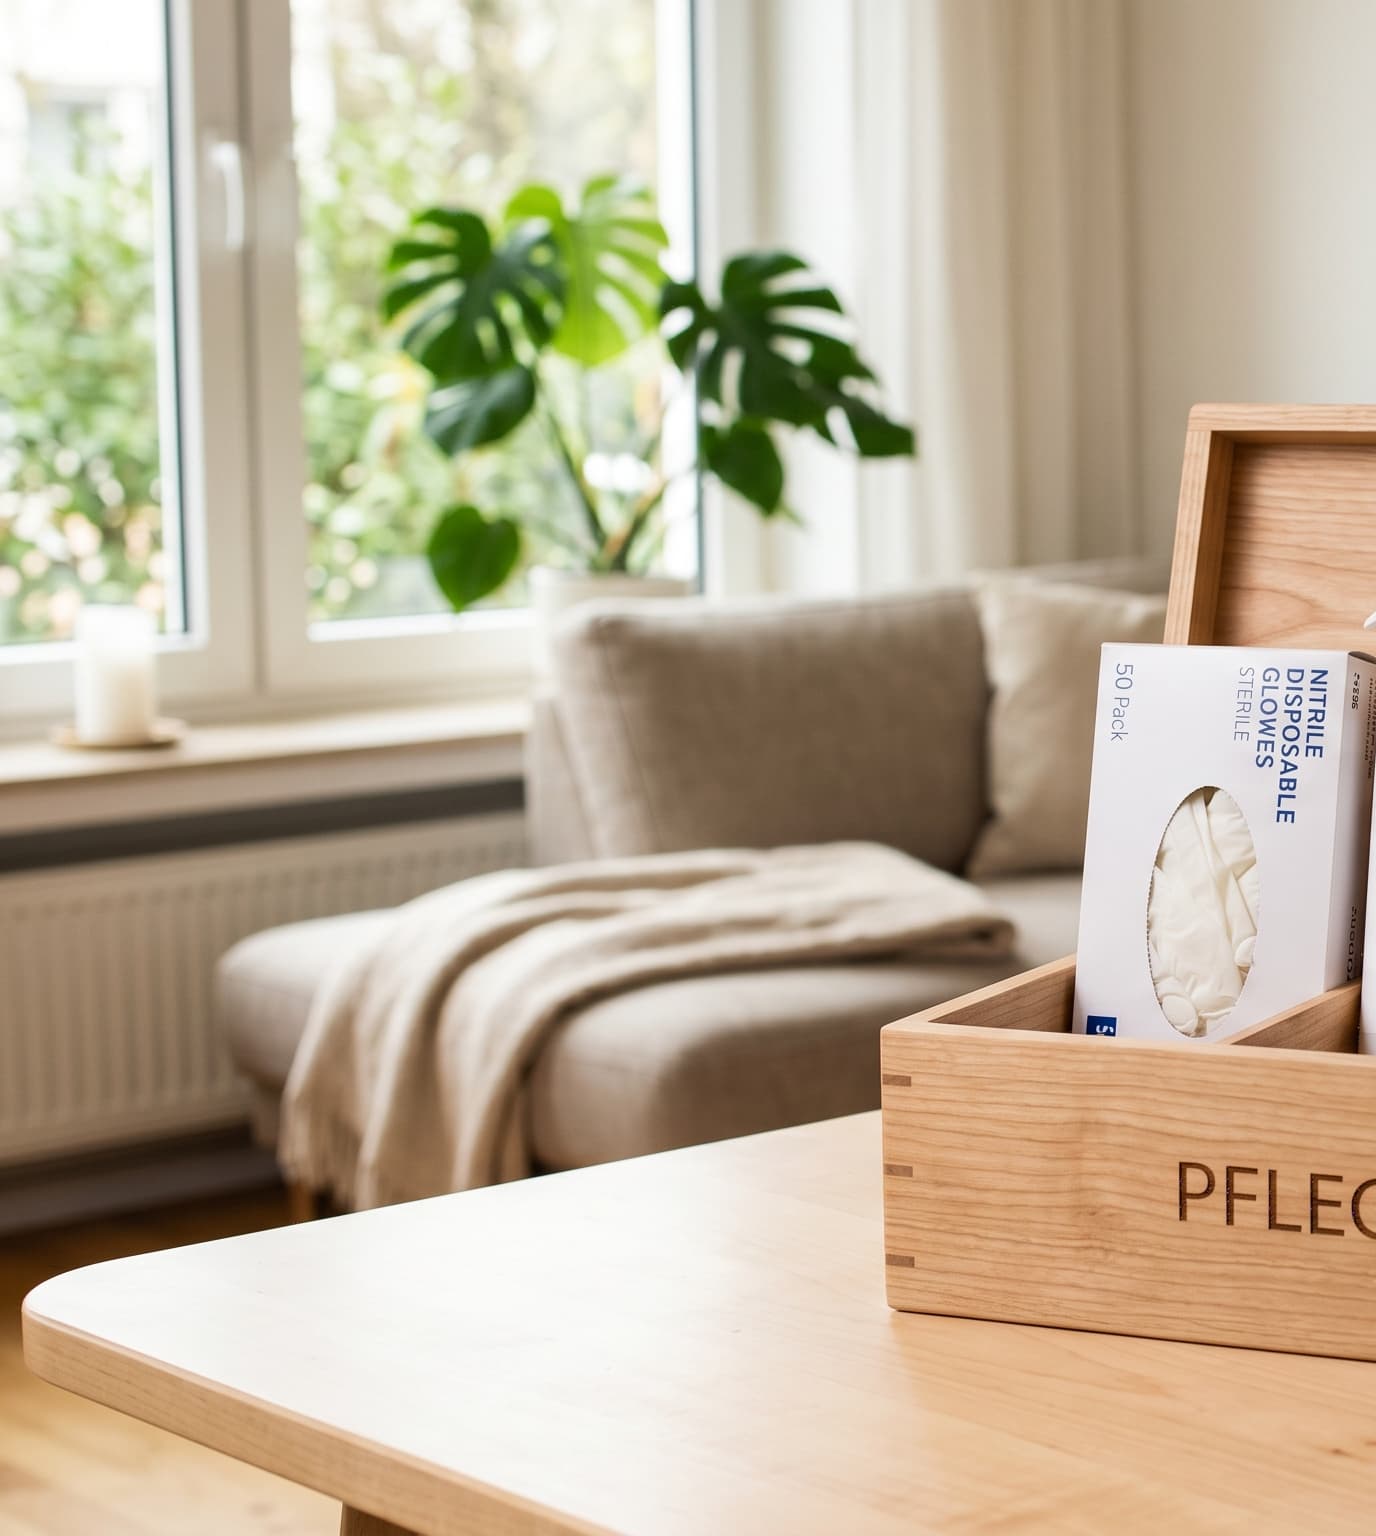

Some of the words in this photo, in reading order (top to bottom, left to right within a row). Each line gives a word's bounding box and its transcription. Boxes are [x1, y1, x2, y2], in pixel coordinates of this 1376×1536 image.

[1115, 663, 1134, 690] 50
[1233, 666, 1255, 742] STERILE
[1305, 669, 1329, 758] NITRILE
[1110, 696, 1130, 742] Pack
[1255, 667, 1281, 769] GLOWES
[1276, 668, 1305, 824] DISPOSABLE
